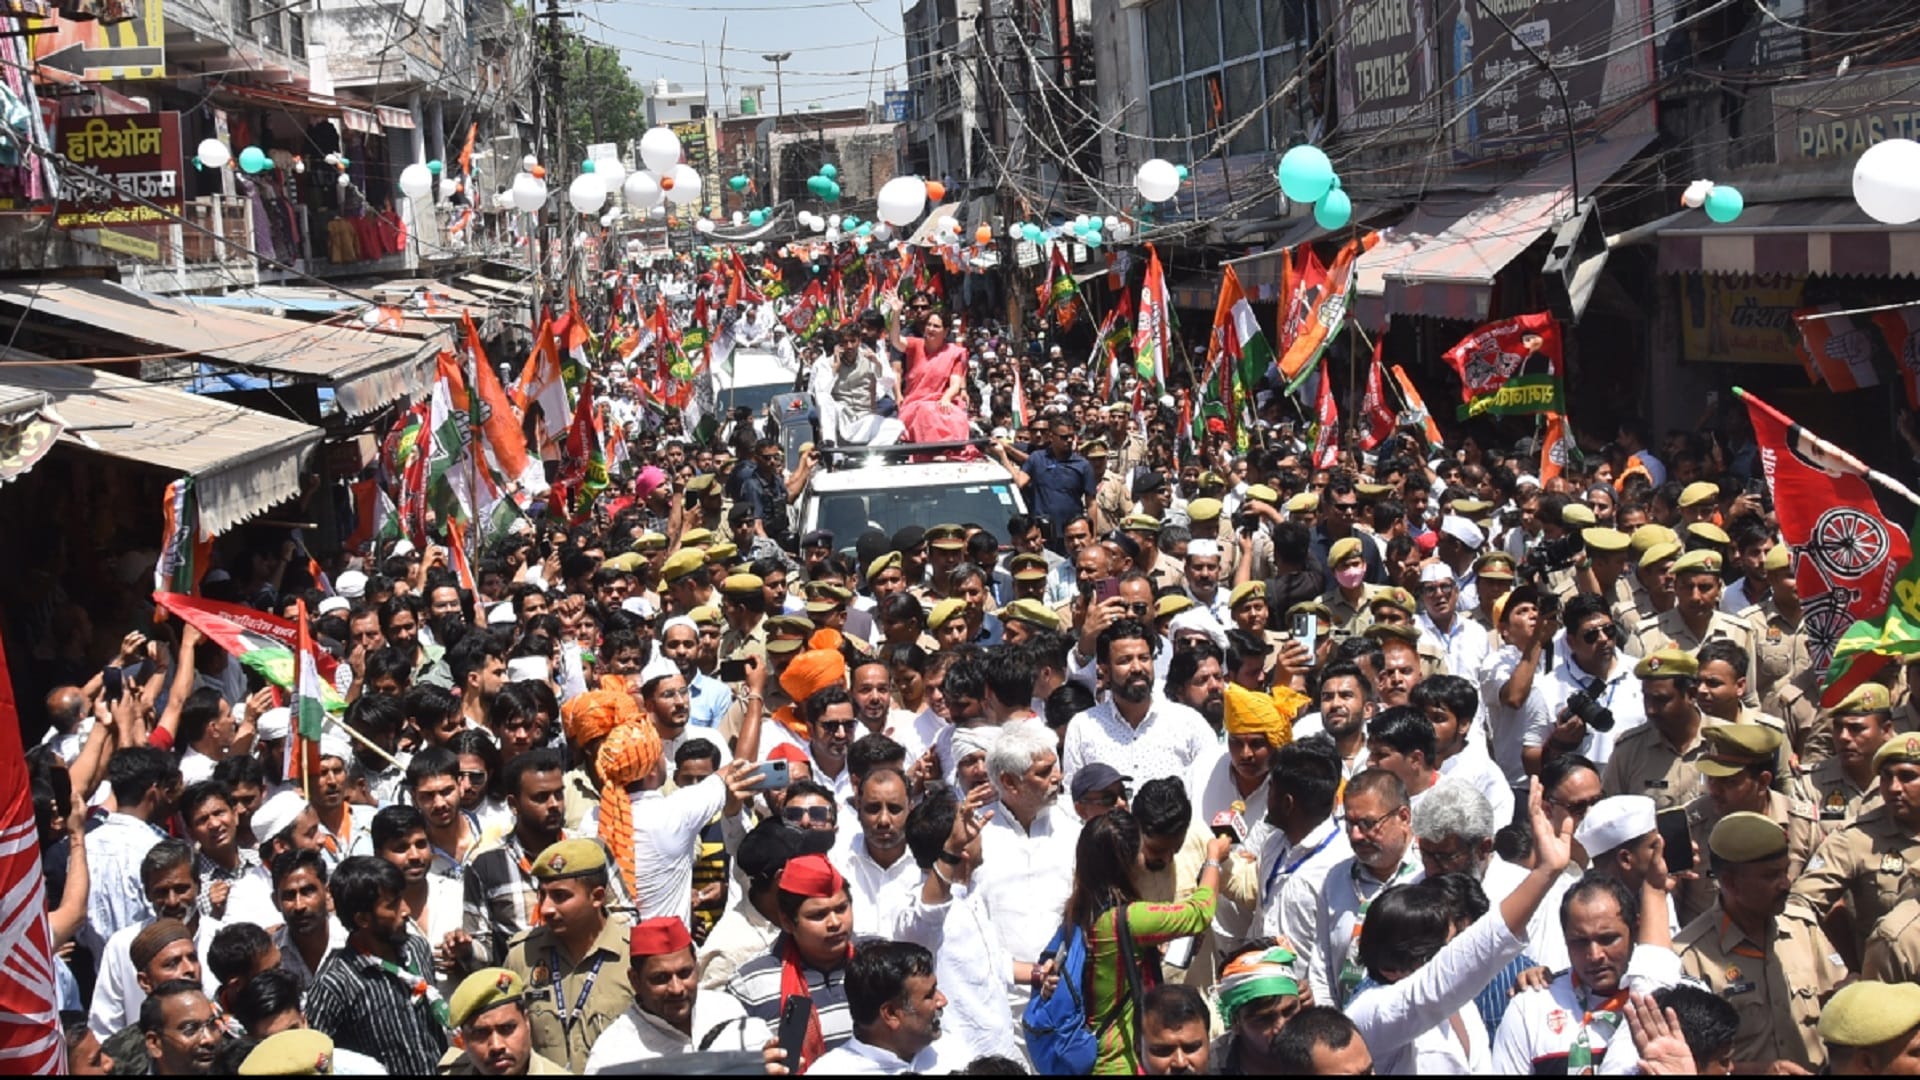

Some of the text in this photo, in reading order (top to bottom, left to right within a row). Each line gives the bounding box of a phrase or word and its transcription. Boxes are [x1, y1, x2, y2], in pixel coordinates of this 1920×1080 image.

[1351, 0, 1412, 49] ABHISHEK
[1355, 51, 1411, 101] TEXTILES
[66, 118, 162, 162] हरिओम
[1800, 115, 1885, 159] PARAS
[116, 170, 177, 202] हाऊस
